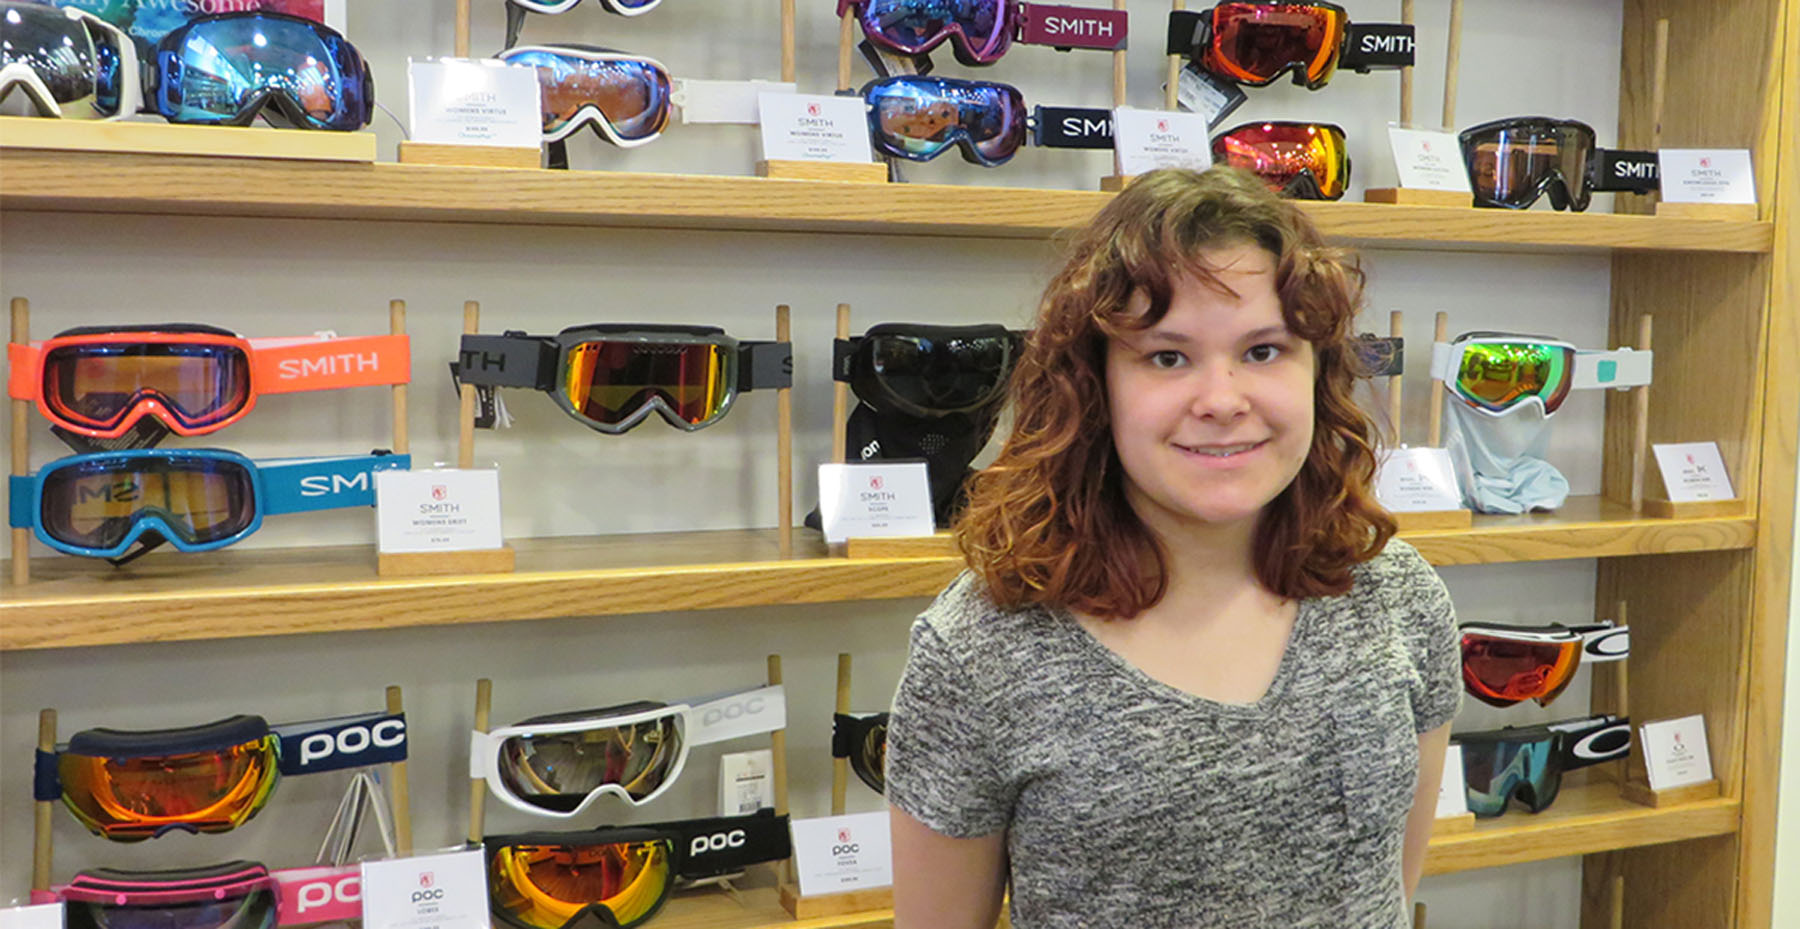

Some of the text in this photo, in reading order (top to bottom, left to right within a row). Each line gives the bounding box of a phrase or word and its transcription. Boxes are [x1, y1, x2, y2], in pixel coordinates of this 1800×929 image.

[1044, 17, 1113, 37] SMITH
[798, 118, 833, 128] SMITH
[279, 352, 379, 380] SMITH
[860, 492, 896, 501] SMITH
[420, 504, 460, 514] SMITH
